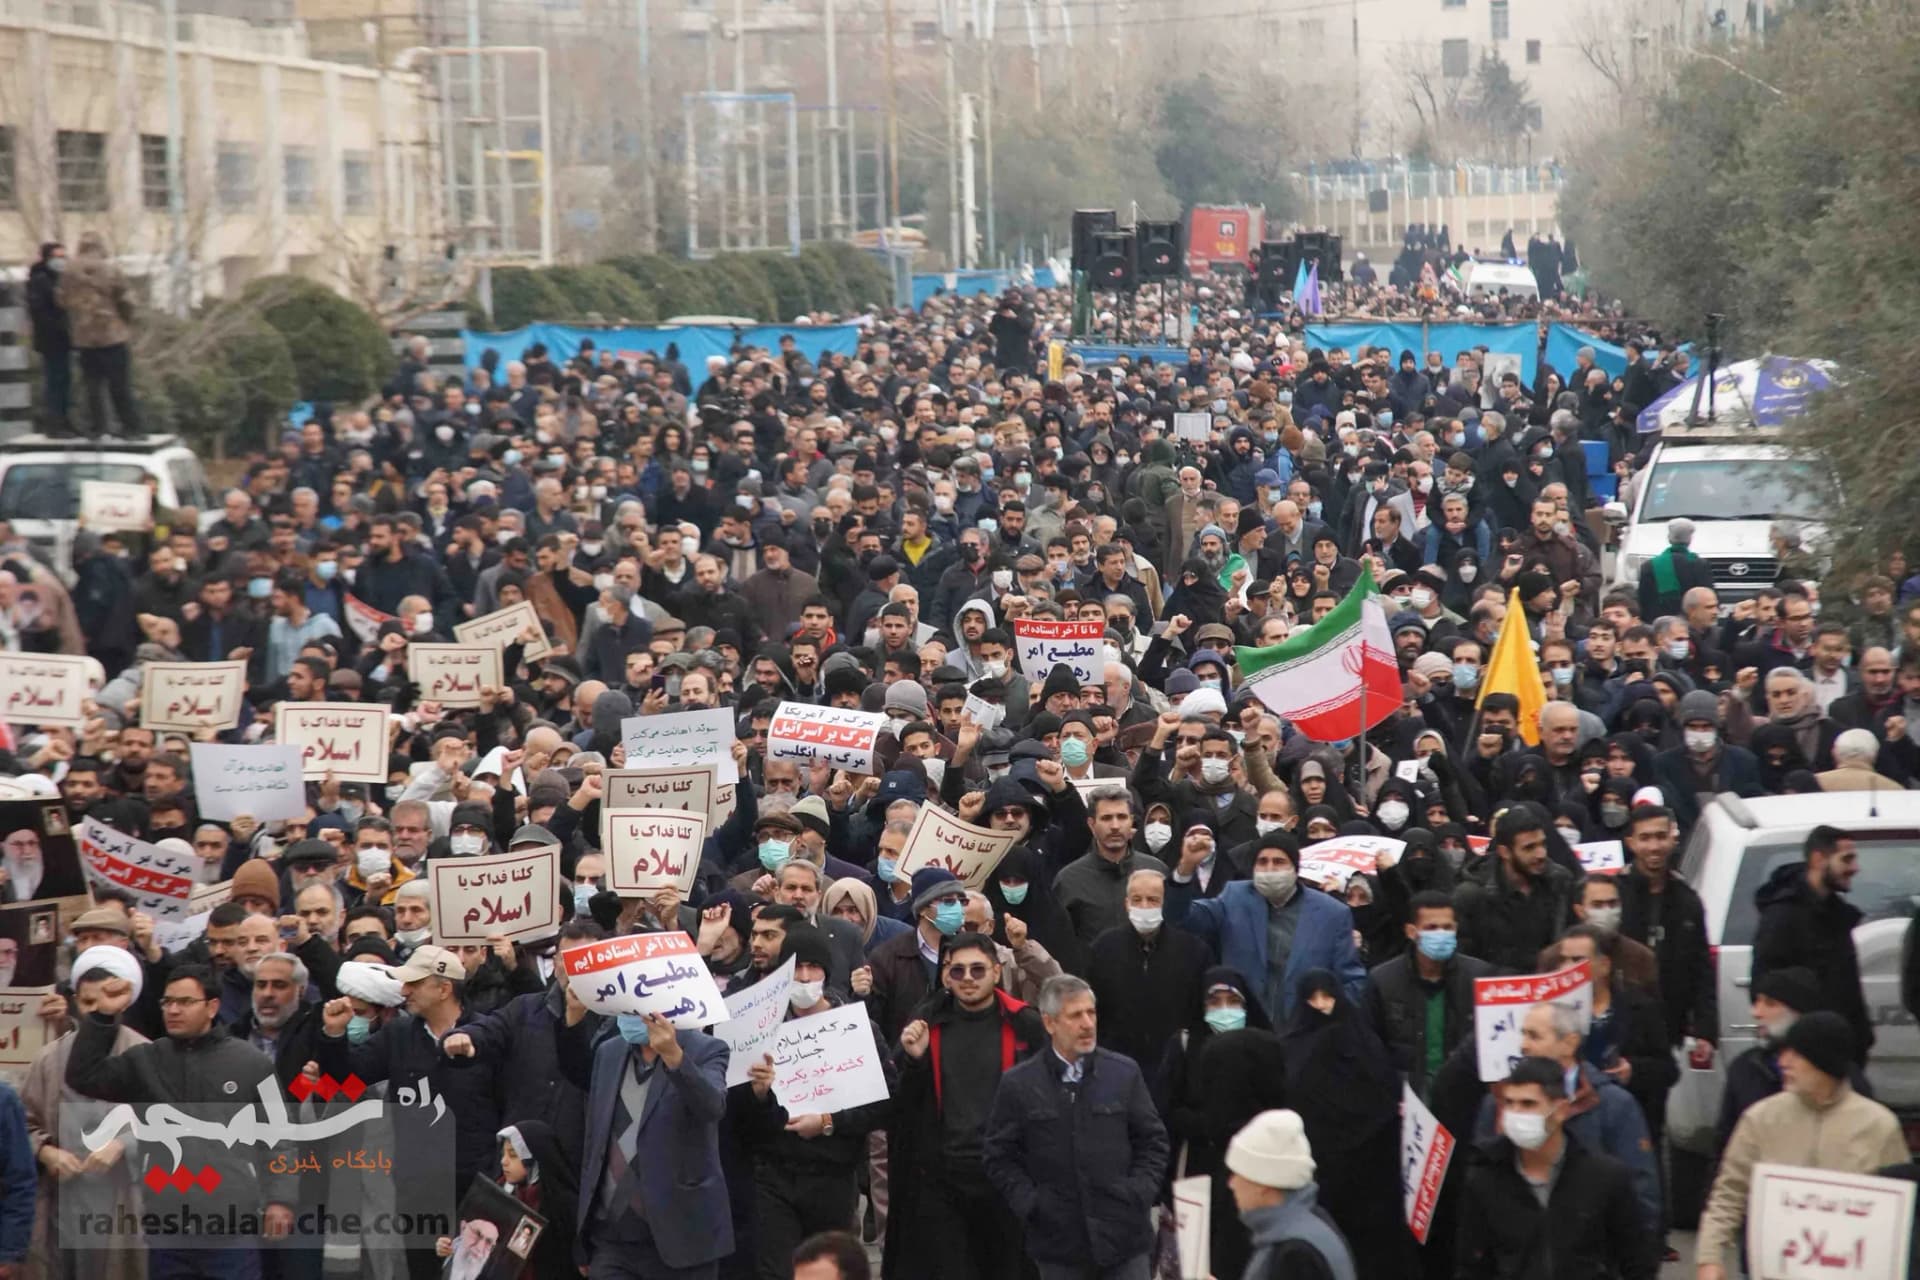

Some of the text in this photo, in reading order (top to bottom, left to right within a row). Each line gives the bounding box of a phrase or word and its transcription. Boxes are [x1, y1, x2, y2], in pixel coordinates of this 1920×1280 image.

[1019, 624, 1098, 638] ما تا آخر ایستاده ایم
[1026, 641, 1095, 662] مطیع امر
[432, 672, 481, 697] اسلام
[784, 706, 875, 728] مرگ بر آمریکا
[774, 720, 872, 748] مرگ بر اسرائیل
[302, 736, 361, 770] اسلام
[773, 744, 817, 759] انگلیس
[836, 751, 867, 769] مرگ
[626, 780, 693, 796] کلنا فداک یا
[628, 824, 693, 841] کلنا فداک یا
[935, 825, 997, 854] کلنا فداک یا
[457, 865, 534, 891] کلنا فداک یا
[632, 848, 688, 884] اسلام
[463, 891, 532, 934] اسلام
[437, 962, 447, 973] 3
[574, 937, 688, 973] ما تا آخر ایستاده ایم
[594, 960, 700, 1003] مطیع امر
[774, 1047, 825, 1066] جسارت
[1779, 1228, 1865, 1274] اسلام
